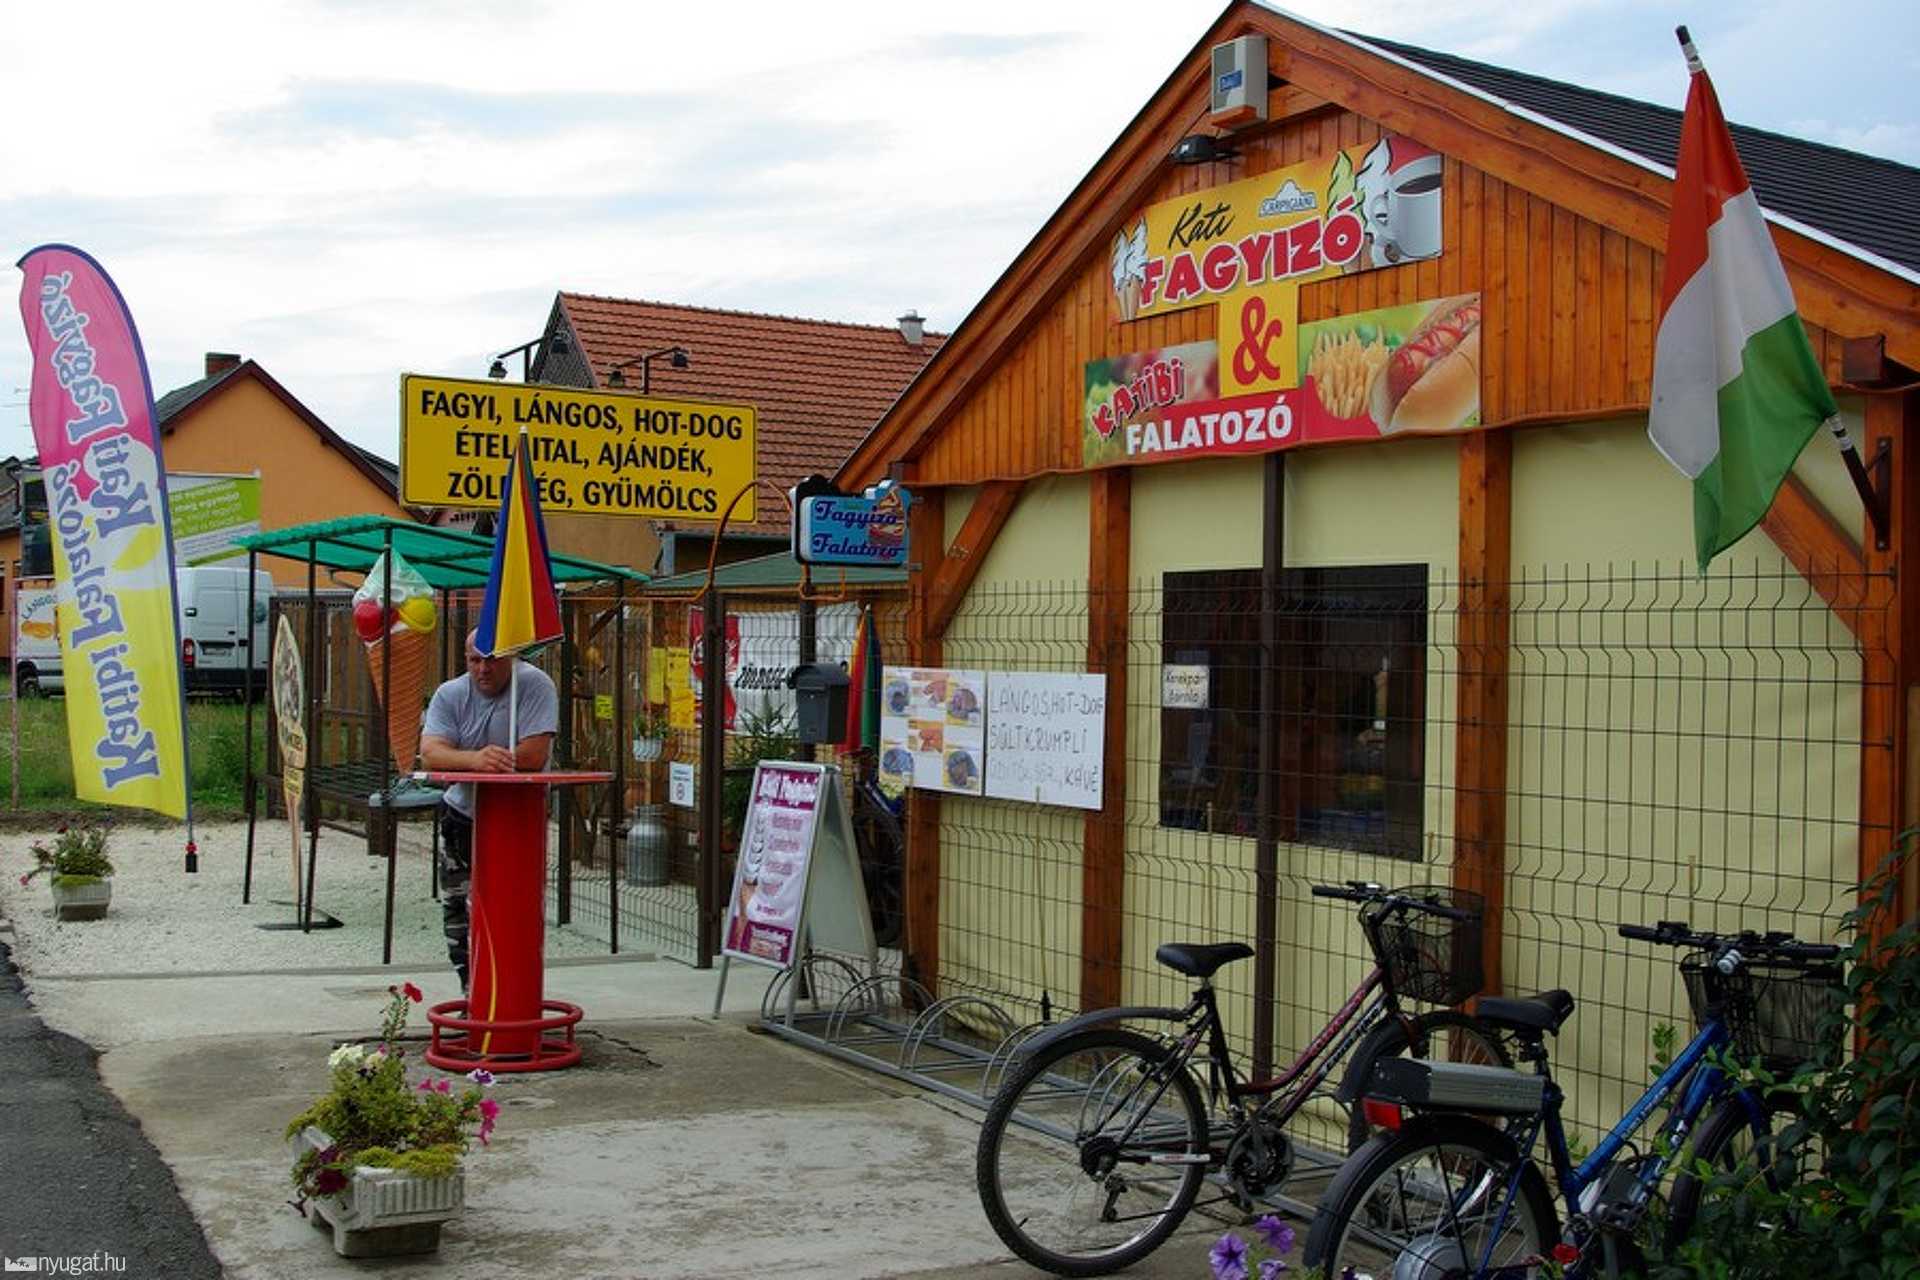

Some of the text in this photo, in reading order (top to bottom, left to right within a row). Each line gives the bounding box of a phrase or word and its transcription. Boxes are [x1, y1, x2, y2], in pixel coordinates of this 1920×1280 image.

[1140, 196, 1365, 306] FAGYIZÓ
[1167, 202, 1236, 249] Kati
[1232, 295, 1284, 386] &
[421, 389, 743, 441] FAGYI, LÁNGOS, HOT-DOG
[1125, 394, 1292, 455] FALATOZÓ
[532, 436, 590, 468] ITAL,
[598, 438, 713, 477] AJÁNDÉK,
[448, 467, 718, 513] ZÖLÉG, GYÜMÖLCS
